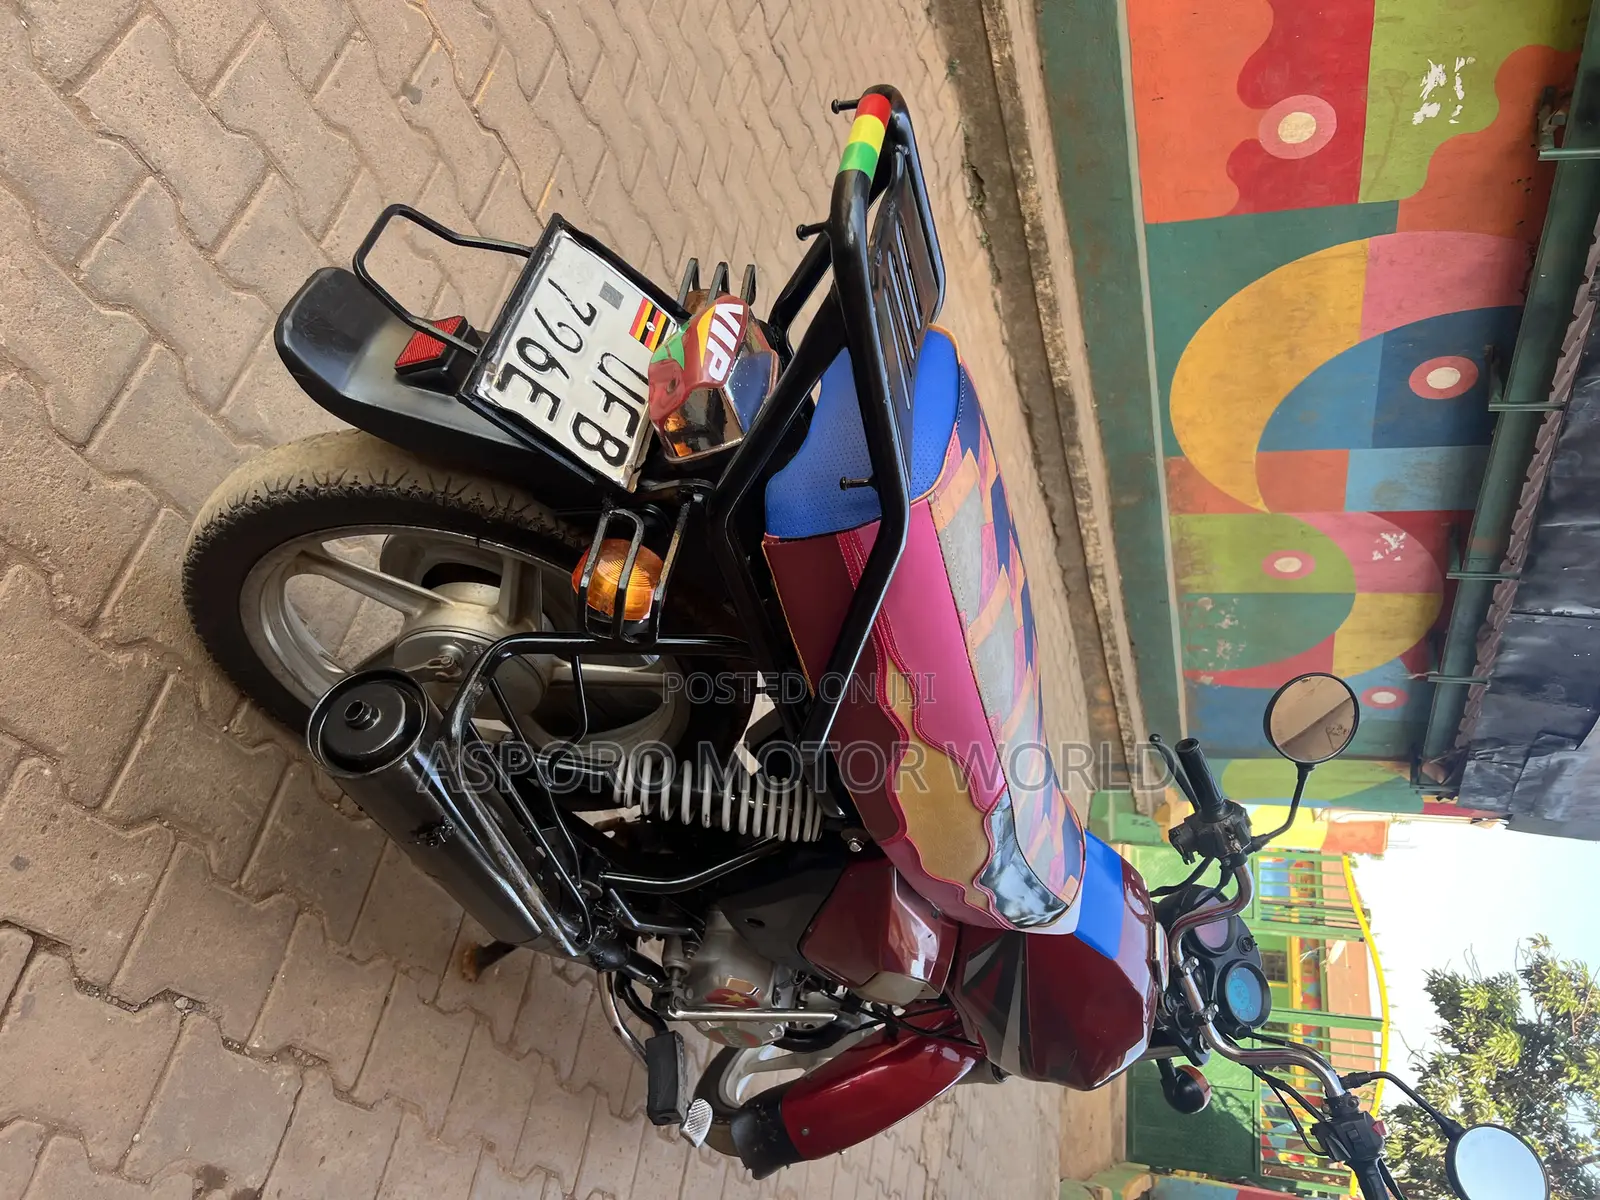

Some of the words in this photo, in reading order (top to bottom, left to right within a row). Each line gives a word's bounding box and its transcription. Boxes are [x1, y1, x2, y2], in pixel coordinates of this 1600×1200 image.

[495, 278, 597, 422] 796E
[706, 302, 744, 382] VIP
[571, 352, 650, 467] UFB
